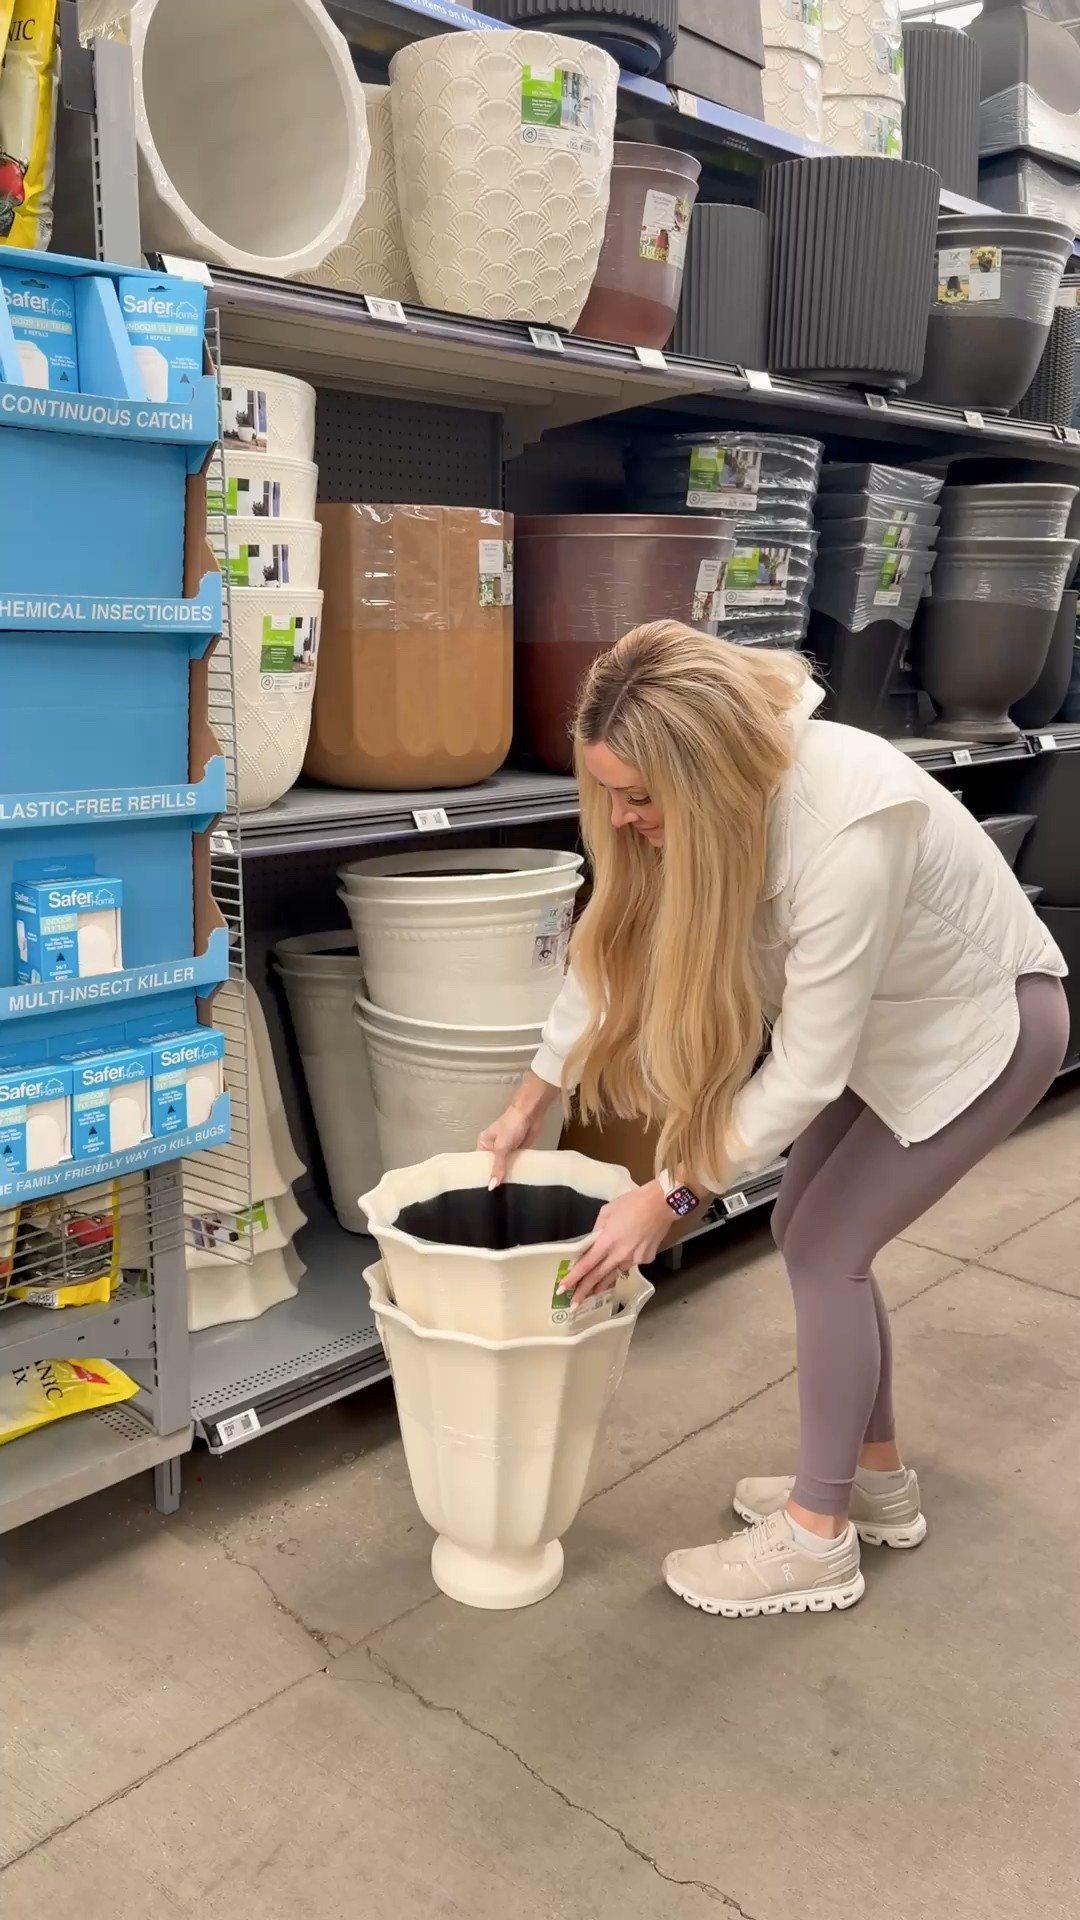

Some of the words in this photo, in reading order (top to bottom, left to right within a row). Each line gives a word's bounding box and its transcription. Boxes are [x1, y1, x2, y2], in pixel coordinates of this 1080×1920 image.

[448, 10, 460, 20] on
[461, 13, 476, 26] the
[3, 287, 48, 310] Safer
[47, 306, 73, 319] Home
[123, 294, 173, 315] Safer
[171, 308, 198, 320] Home
[2, 394, 131, 426] CONTINUOUS
[136, 410, 193, 430] CATCH
[0, 600, 86, 619] HEMICAL
[91, 603, 213, 621] INSECTICIDES
[0, 797, 122, 819] LASTIC-FREE
[128, 791, 197, 811] REFILLS
[48, 889, 93, 908] Safer
[92, 897, 115, 907] Home
[9, 979, 133, 1012] MULTI-INSECT
[137, 966, 194, 990] KILLER
[161, 1046, 200, 1066] Safer
[198, 1050, 218, 1061] Home
[82, 1065, 125, 1086] Safer
[122, 1068, 145, 1079] Home
[0, 1081, 43, 1101] Safer
[40, 1085, 64, 1097] Home
[16, 1172, 62, 1192] FAMILY
[64, 1157, 124, 1180] FRIENDLY
[125, 1148, 150, 1165] WAY
[152, 1143, 167, 1156] TO
[169, 1137, 192, 1153] KILL
